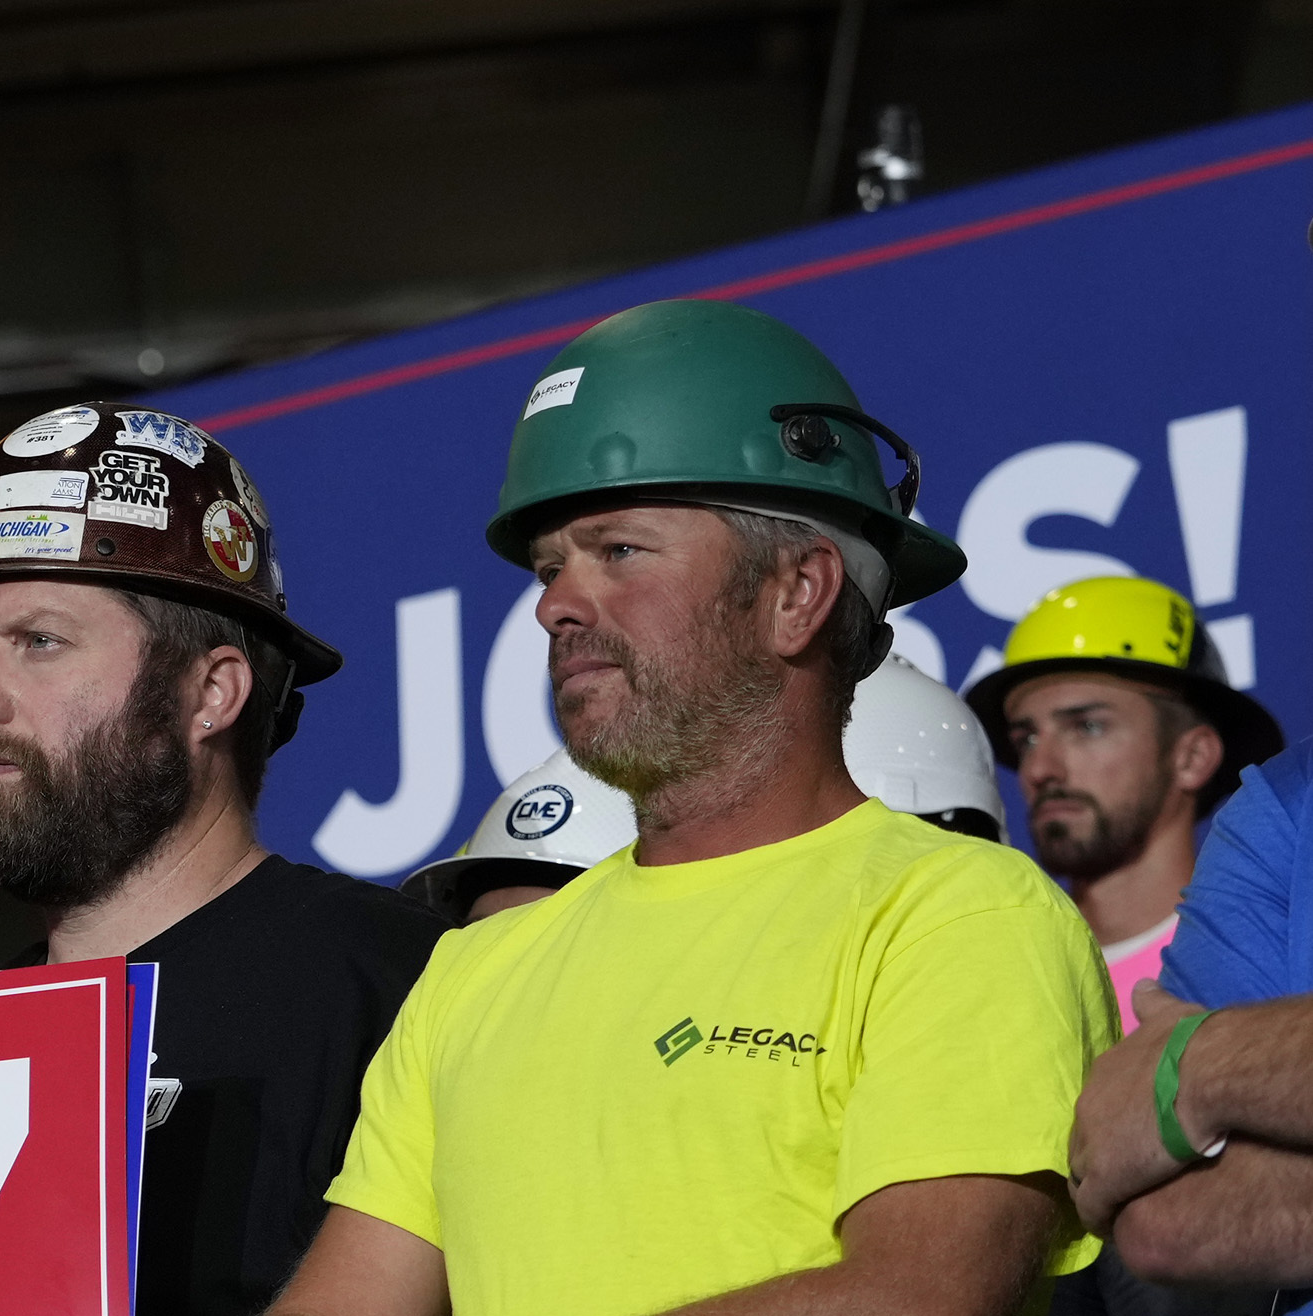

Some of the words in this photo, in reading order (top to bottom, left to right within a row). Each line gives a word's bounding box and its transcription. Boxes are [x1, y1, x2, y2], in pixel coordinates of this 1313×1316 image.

[542, 380, 576, 395] LEGACY
[102, 453, 157, 472] GET
[95, 468, 165, 493] YOUR
[99, 484, 161, 508] OWN
[36, 547, 52, 555] your
[311, 405, 1258, 878] JS!
[516, 802, 561, 819] CME
[709, 1025, 827, 1057] LEGAC
[703, 1044, 801, 1067] STEEL
